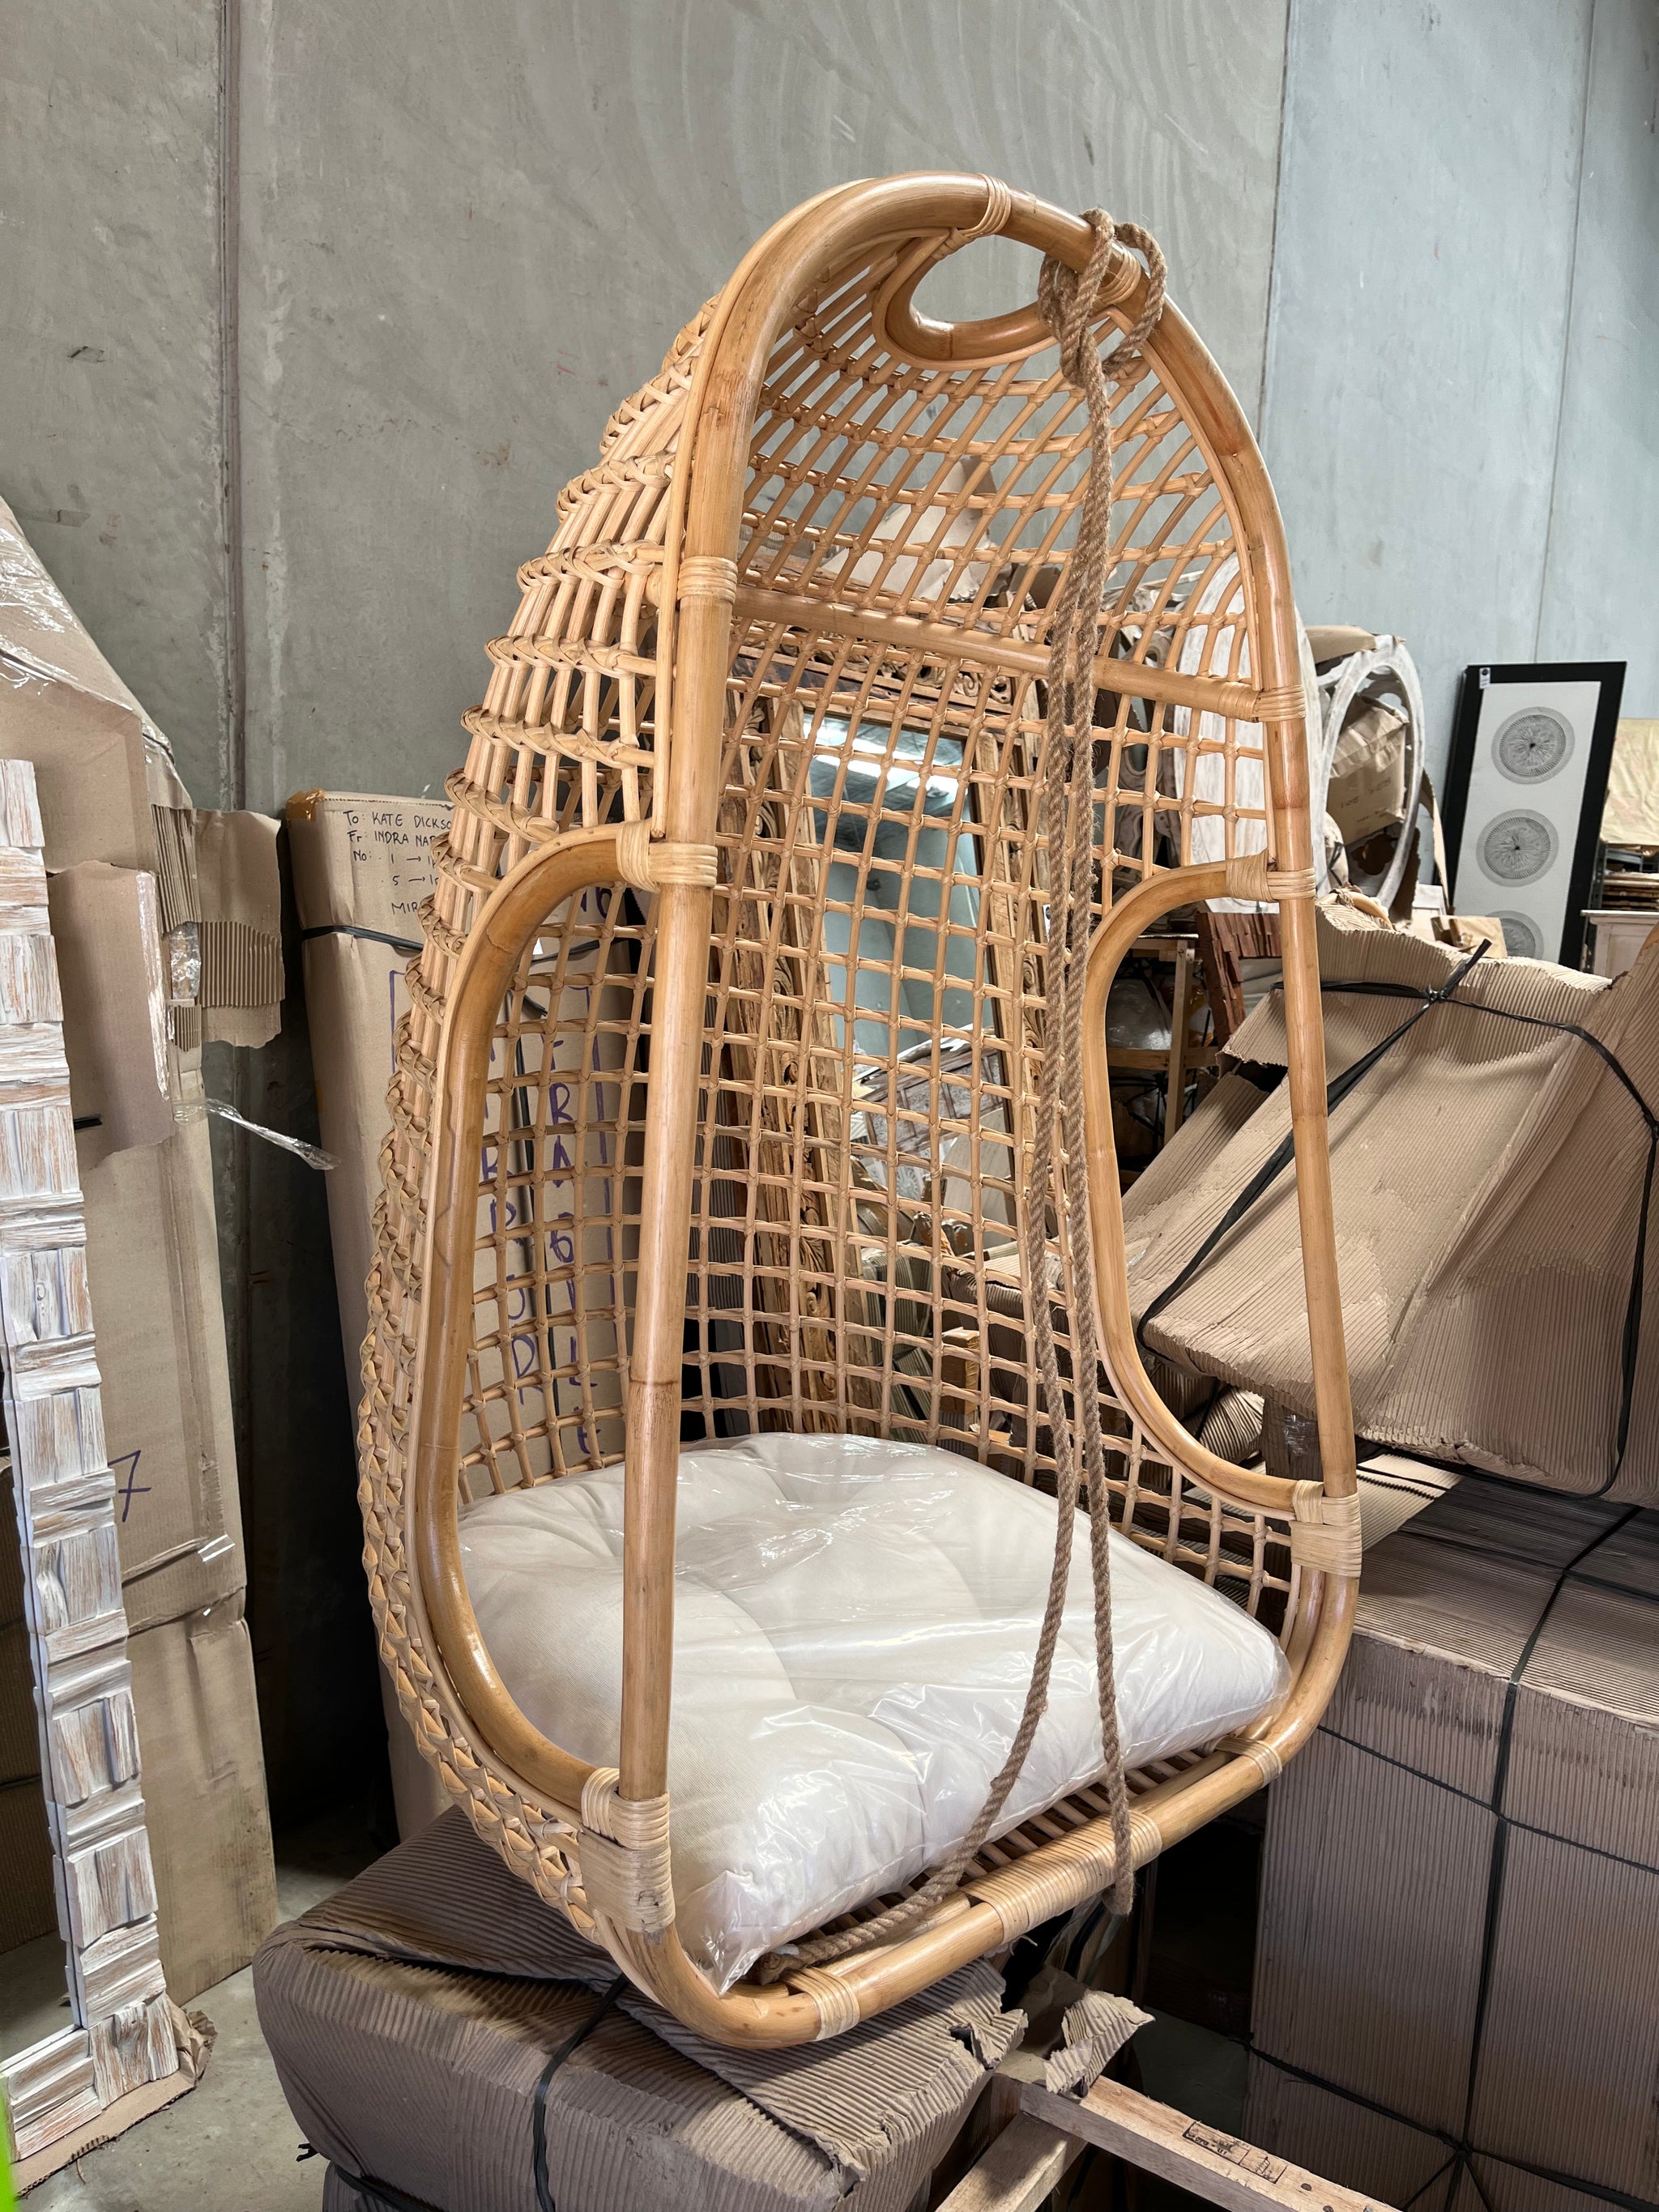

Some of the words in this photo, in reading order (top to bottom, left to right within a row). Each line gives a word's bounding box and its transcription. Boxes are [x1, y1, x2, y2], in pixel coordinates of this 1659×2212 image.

[343, 810, 366, 826] To:
[372, 811, 403, 827] KATE
[374, 830, 410, 845] INDRA
[416, 834, 436, 847] NA
[353, 849, 373, 862] No:
[392, 875, 401, 887] 5
[107, 1449, 152, 1523] 7
